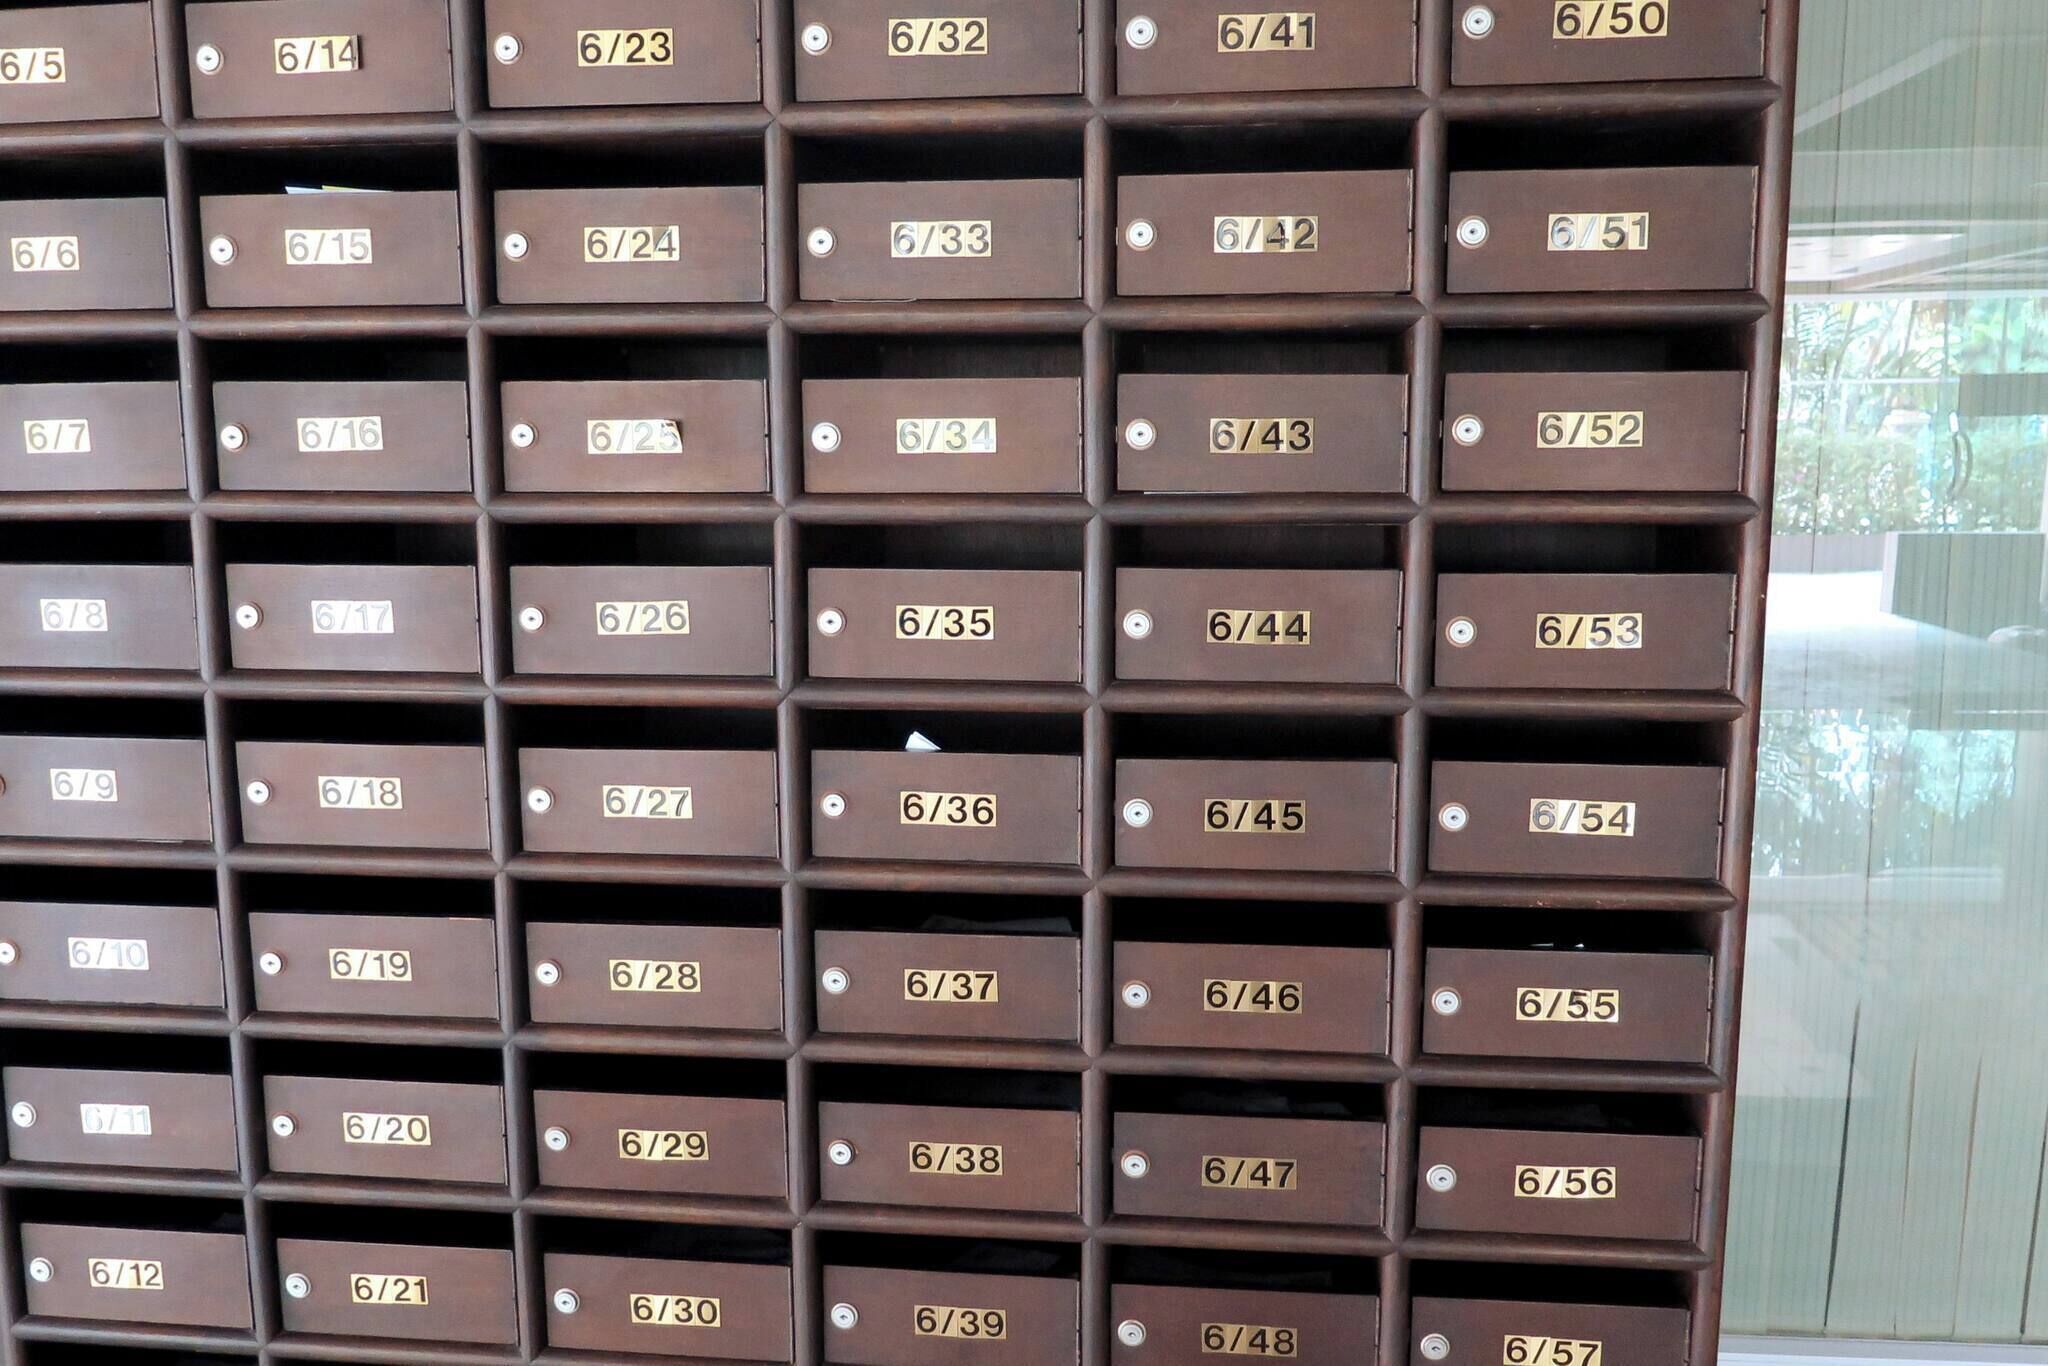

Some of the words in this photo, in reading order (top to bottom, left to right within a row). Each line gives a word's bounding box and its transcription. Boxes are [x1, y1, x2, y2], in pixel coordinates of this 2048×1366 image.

[1220, 14, 1315, 50] 6/41
[1555, 0, 1665, 36] 6/50
[579, 31, 672, 64] 6/23
[890, 20, 987, 54] 6/32
[0, 51, 64, 81] 6/5
[288, 232, 369, 261] 6/15
[586, 229, 677, 259] 6/24
[892, 225, 990, 255] 6/33
[1215, 217, 1316, 251] 6/42
[1550, 215, 1647, 249] 6/51
[13, 239, 78, 269] 6/6
[26, 422, 88, 451] 6/7
[300, 418, 381, 449] 6/16
[590, 421, 679, 452] 6/25
[898, 421, 995, 451] 6/34
[1211, 419, 1312, 451] 6/43
[1539, 413, 1641, 445] 6/52
[42, 601, 106, 630] 6/8
[314, 602, 391, 631] 6/17
[599, 602, 688, 633] 6/26
[898, 607, 992, 638] 6/35
[1208, 611, 1308, 643] 6/44
[1537, 614, 1640, 647] 6/53
[52, 771, 116, 800] 6/9
[321, 778, 400, 807] 6/18
[605, 787, 690, 817] 6/27
[902, 793, 994, 823] 6/36
[1206, 800, 1305, 832] 6/45
[1531, 800, 1632, 834] 6/54
[70, 940, 148, 968] 6/10
[332, 950, 410, 979] 6/19
[611, 961, 699, 991] 6/28
[906, 971, 995, 999] 6/37
[1205, 980, 1301, 1013] 6/46
[1518, 989, 1617, 1020] 6/55
[83, 1105, 150, 1132] 6/11
[345, 1114, 428, 1143] 6/20
[620, 1131, 706, 1159] 6/29
[911, 1142, 1001, 1172] 6/38
[1203, 1157, 1296, 1188] 6/47
[1517, 1167, 1614, 1196] 6/56
[90, 1260, 161, 1288] 6/12
[353, 1276, 427, 1304] 6/21
[633, 1296, 719, 1325] 6/30
[915, 1306, 1005, 1338] 6/39
[1203, 1324, 1296, 1355] 6/48
[1505, 1337, 1599, 1366] 6/57
